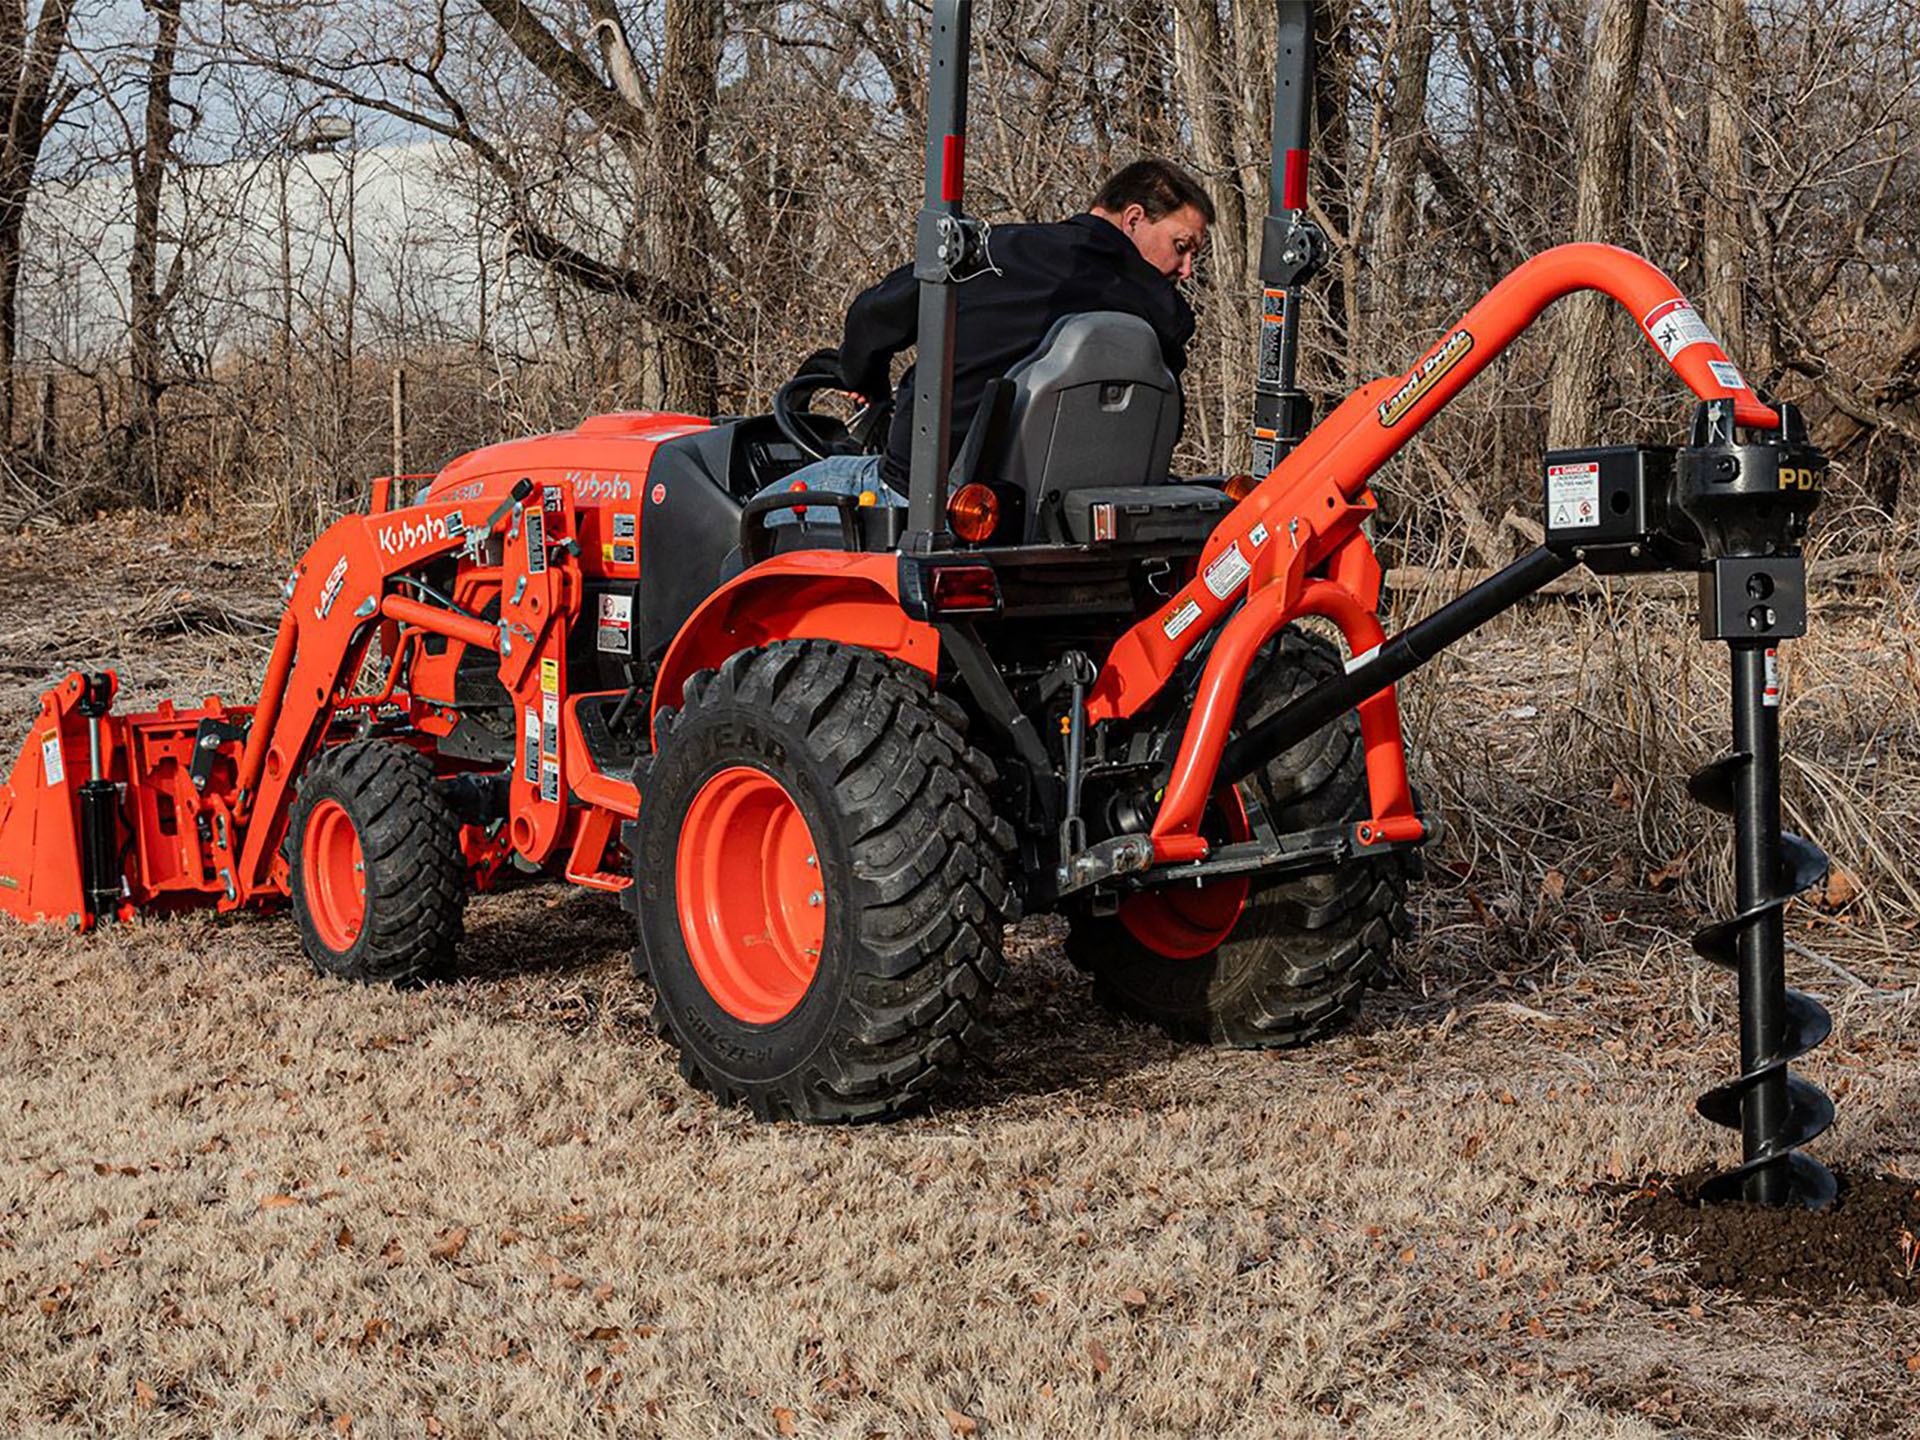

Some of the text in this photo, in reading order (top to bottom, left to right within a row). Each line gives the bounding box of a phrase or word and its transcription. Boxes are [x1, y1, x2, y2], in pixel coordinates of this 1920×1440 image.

[1379, 330, 1467, 419] Land Pride
[379, 513, 446, 555] Kubota
